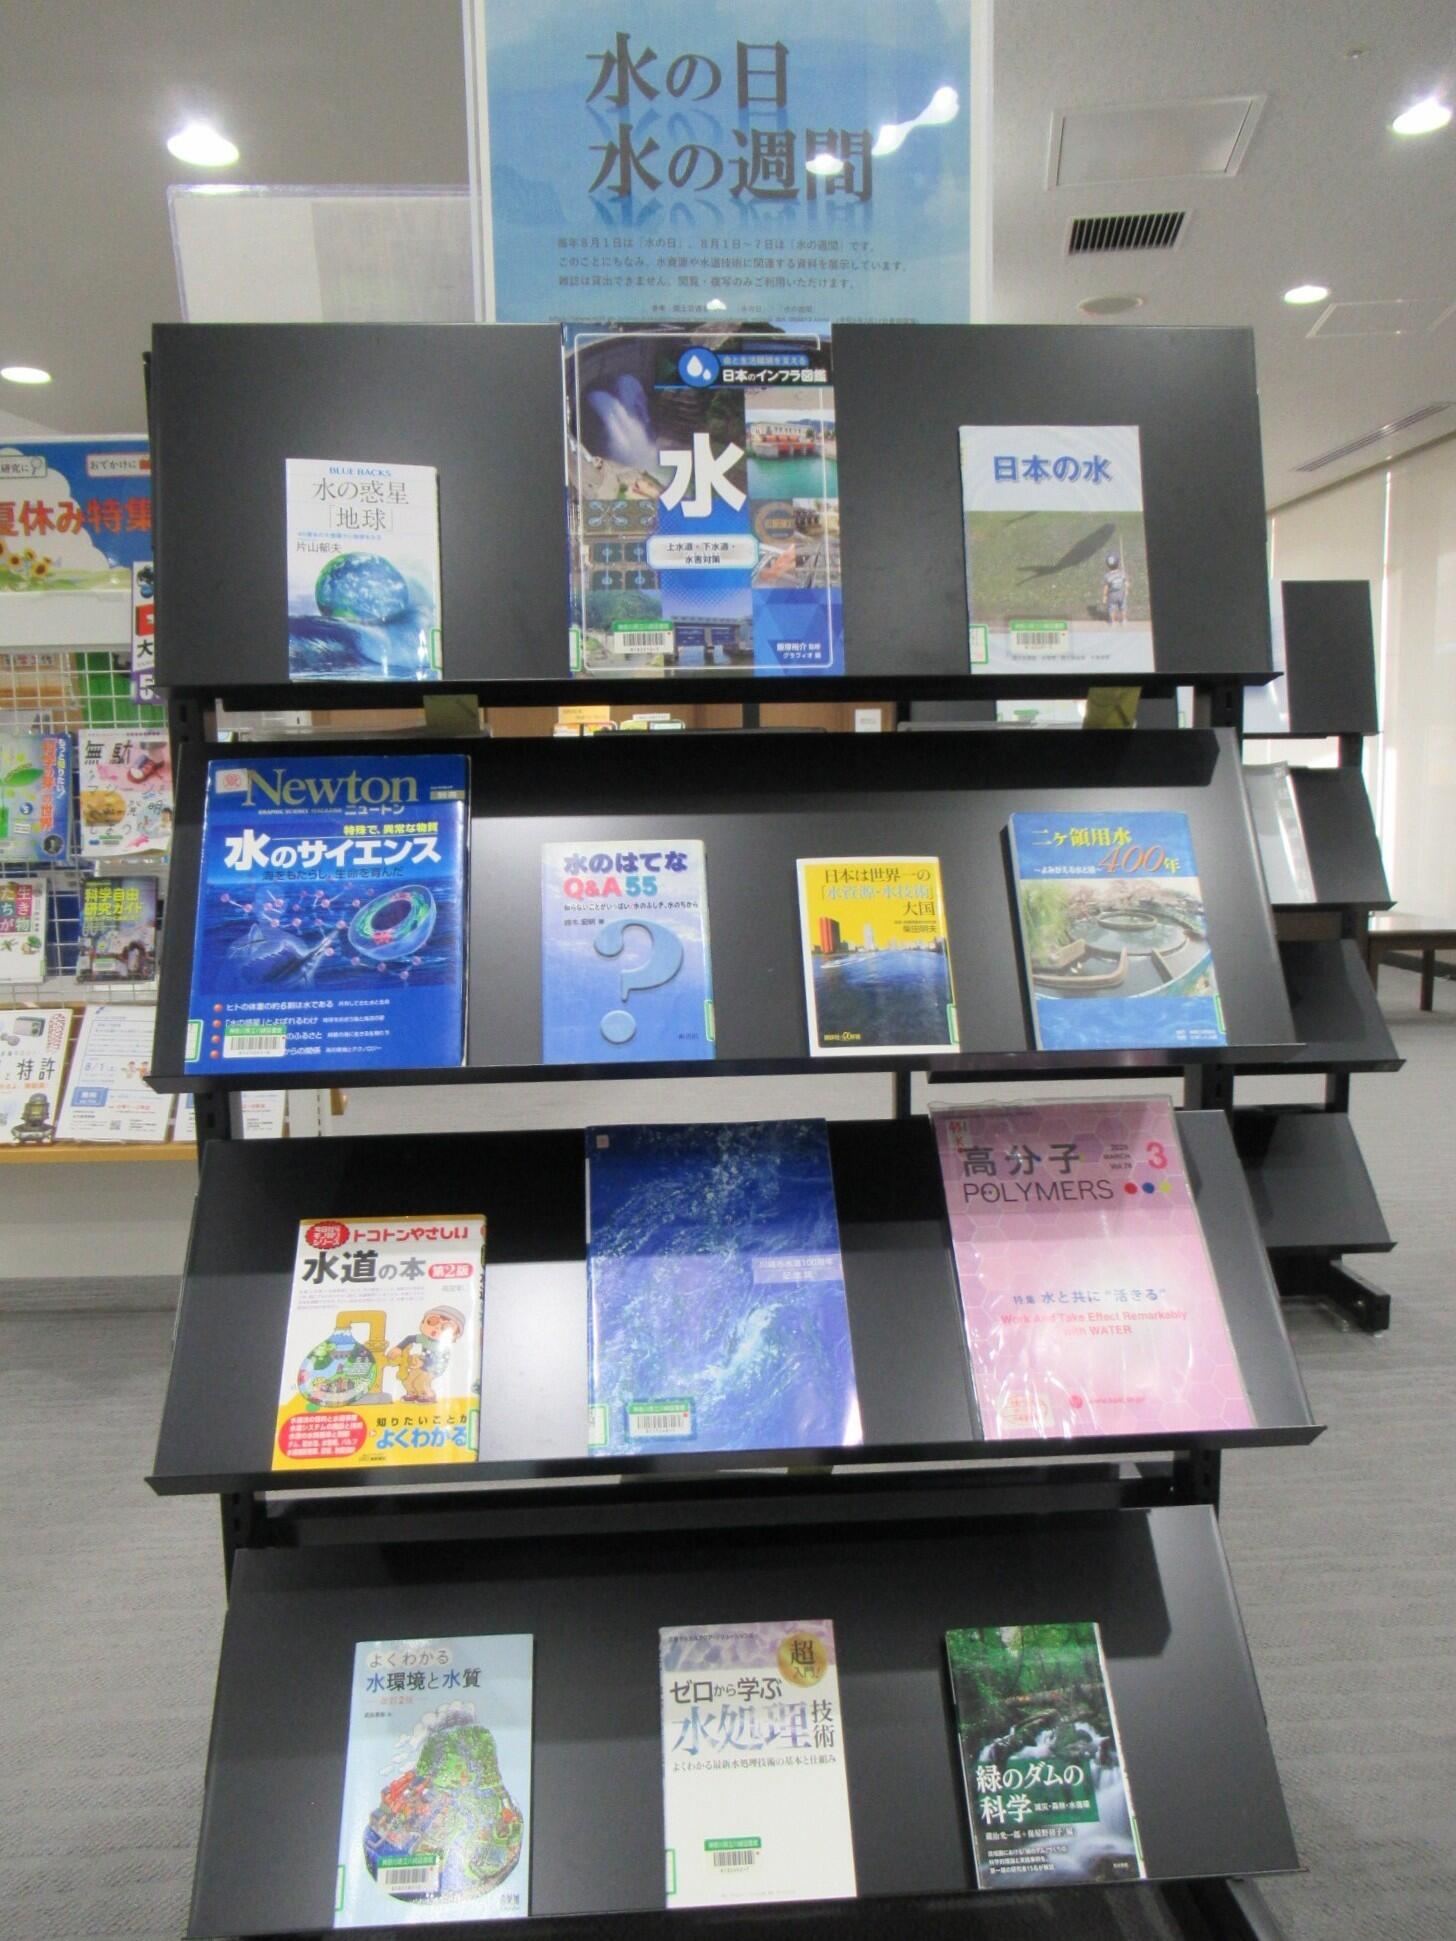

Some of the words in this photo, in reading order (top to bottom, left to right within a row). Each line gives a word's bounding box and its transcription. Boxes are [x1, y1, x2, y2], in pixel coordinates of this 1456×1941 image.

[585, 31, 790, 109] 水の日
[588, 122, 874, 202] 水の週間
[328, 466, 354, 476] BLUE
[356, 468, 392, 477] BACKS
[658, 431, 748, 518] 水
[993, 454, 1113, 485] 日本の水
[312, 477, 410, 505] 水の惑星
[0, 497, 153, 537] 夏休み特集
[241, 767, 420, 808] Newton
[344, 804, 406, 816] ニュートン
[343, 821, 439, 836] 特殊で、異常な物質
[224, 828, 442, 871] 水のサイエンス
[563, 850, 688, 874] 水のはてな
[824, 867, 931, 884] 日本は世界一の
[903, 901, 936, 916] 大国
[963, 1143, 1080, 1178] 高分子
[1146, 1141, 1169, 1169] 3
[963, 1179, 1115, 1204] POLYMERS
[354, 1226, 469, 1243] トコトンやさしい
[302, 1249, 427, 1285] 水道の本
[1058, 1312, 1086, 1323] Take
[1087, 1311, 1120, 1322] Effect
[1122, 1310, 1188, 1322] Remarkably
[1089, 1325, 1133, 1336] WATER
[375, 1425, 468, 1450] よくわかる
[369, 1649, 450, 1669] よくわかる
[790, 1639, 816, 1665] 超
[365, 1667, 482, 1694] 水環境と水質
[670, 1678, 783, 1705] ゼロから学ぶ
[672, 1701, 812, 1756] 水処理
[812, 1699, 835, 1749] 技術
[975, 1762, 1085, 1794] 緑のダムの
[980, 1794, 1033, 1825] 科学
